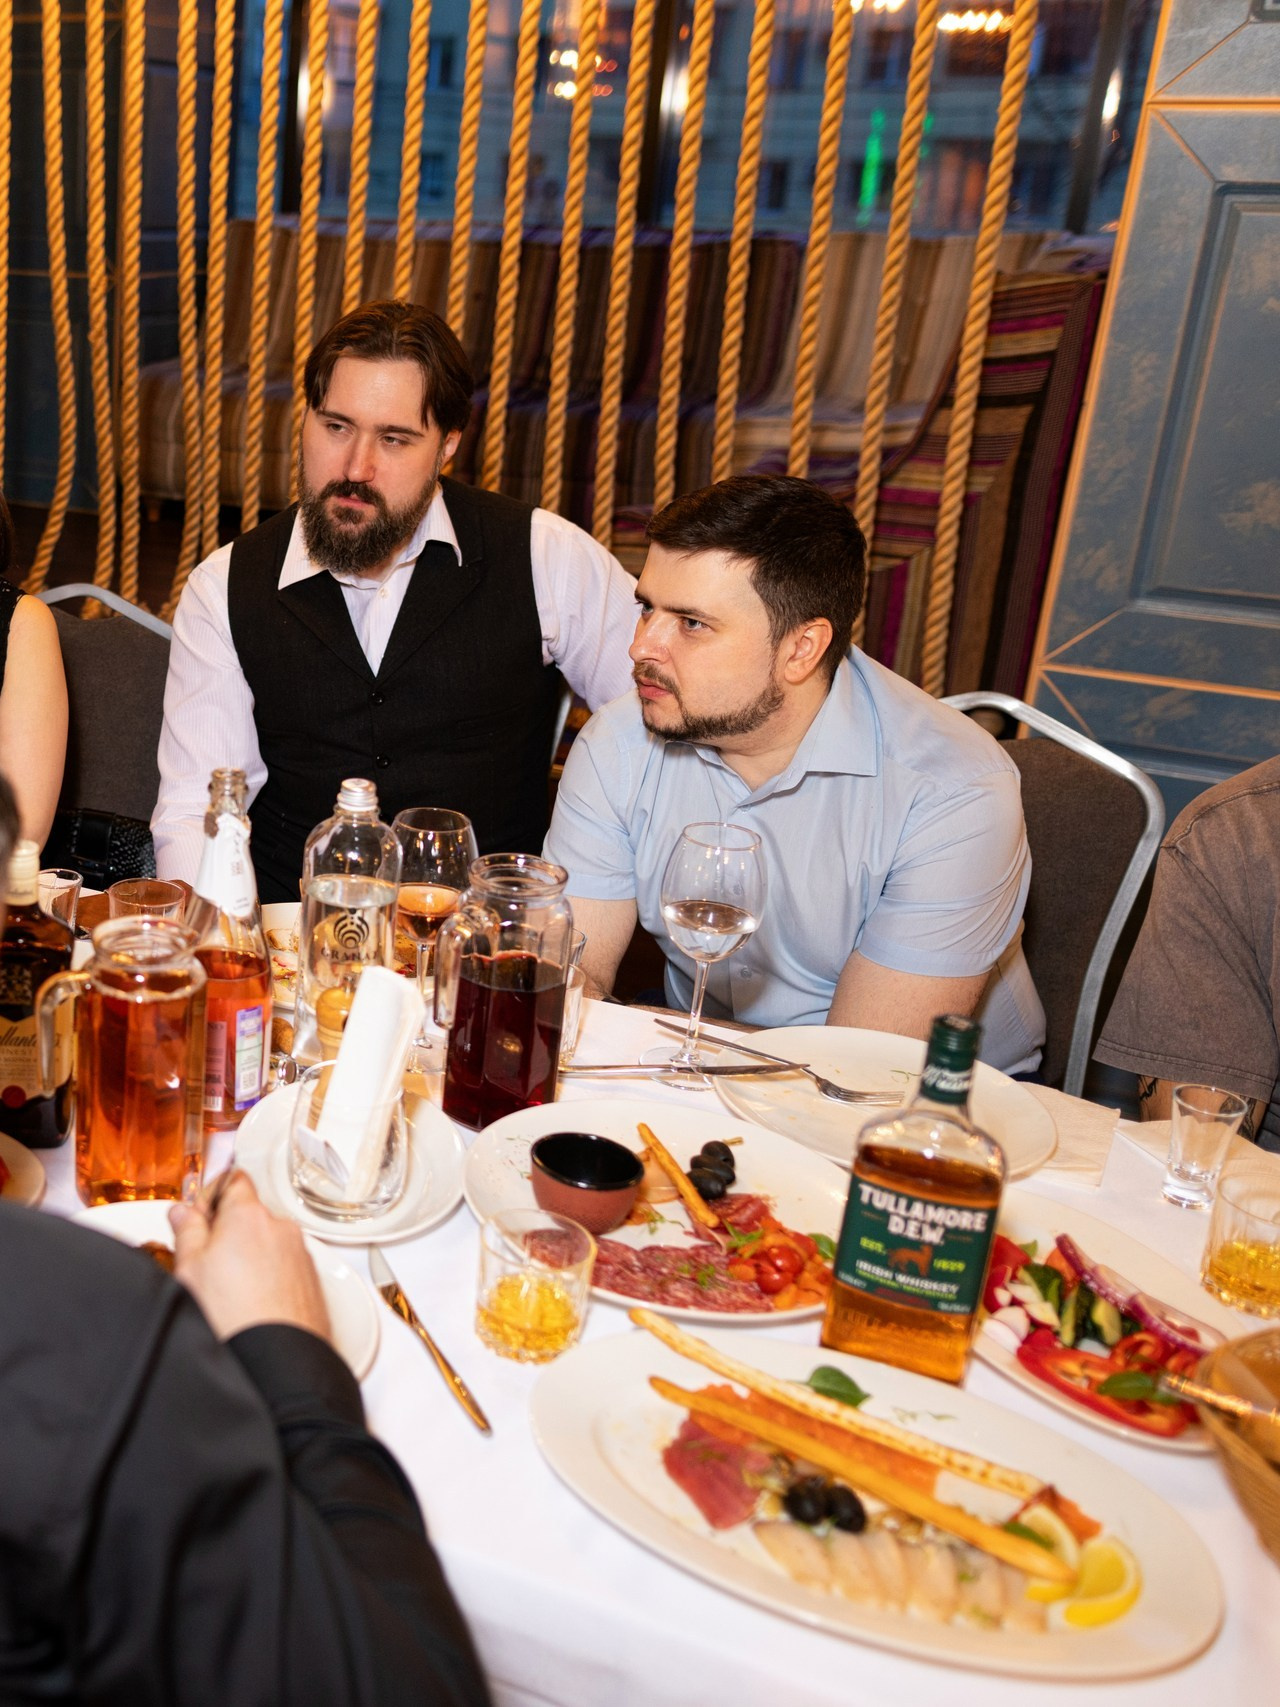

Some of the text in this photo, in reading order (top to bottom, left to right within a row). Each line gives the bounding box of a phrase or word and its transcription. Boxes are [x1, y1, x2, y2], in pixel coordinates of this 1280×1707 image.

[858, 1183, 988, 1232] TULLAMORE
[855, 1259, 894, 1280] IRISH
[895, 1272, 960, 1295] WHISKEY
